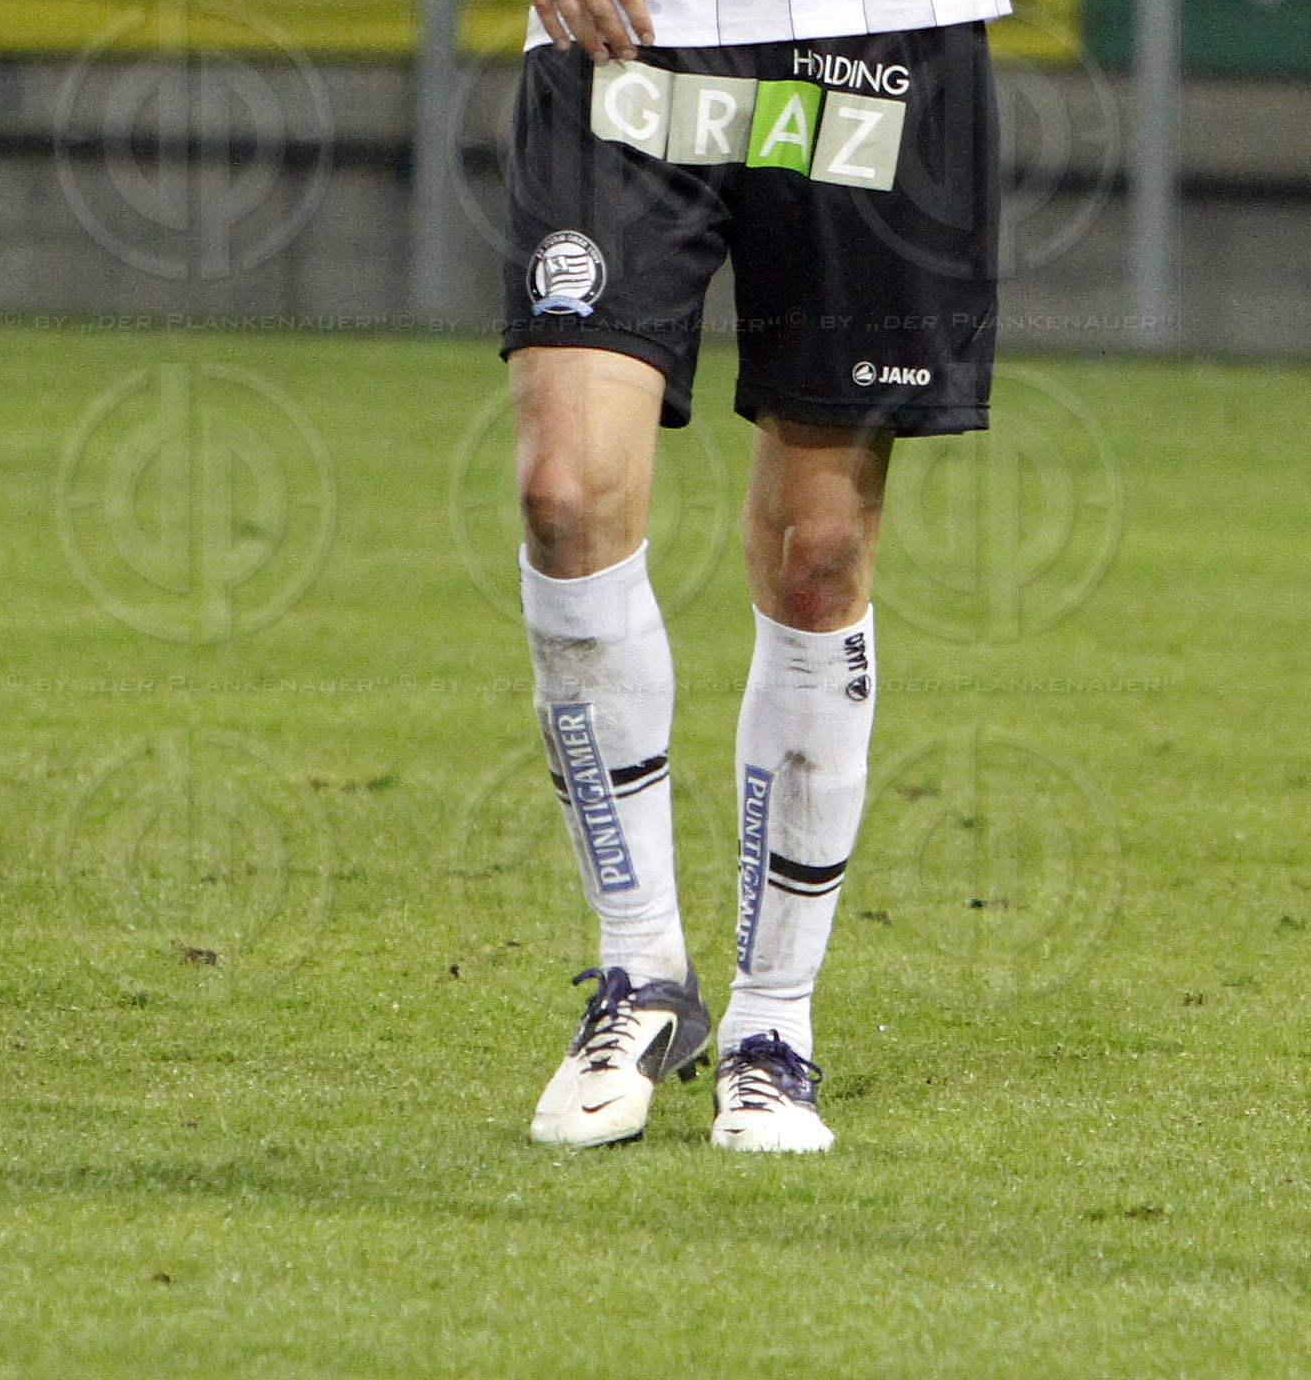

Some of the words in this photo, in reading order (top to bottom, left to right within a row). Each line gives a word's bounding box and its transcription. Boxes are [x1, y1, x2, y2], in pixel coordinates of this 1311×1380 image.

[603, 72, 884, 180] GRAZ
[878, 366, 931, 386] JAKO
[844, 632, 868, 672] JAKO
[558, 714, 633, 886] PUNTIGAMER
